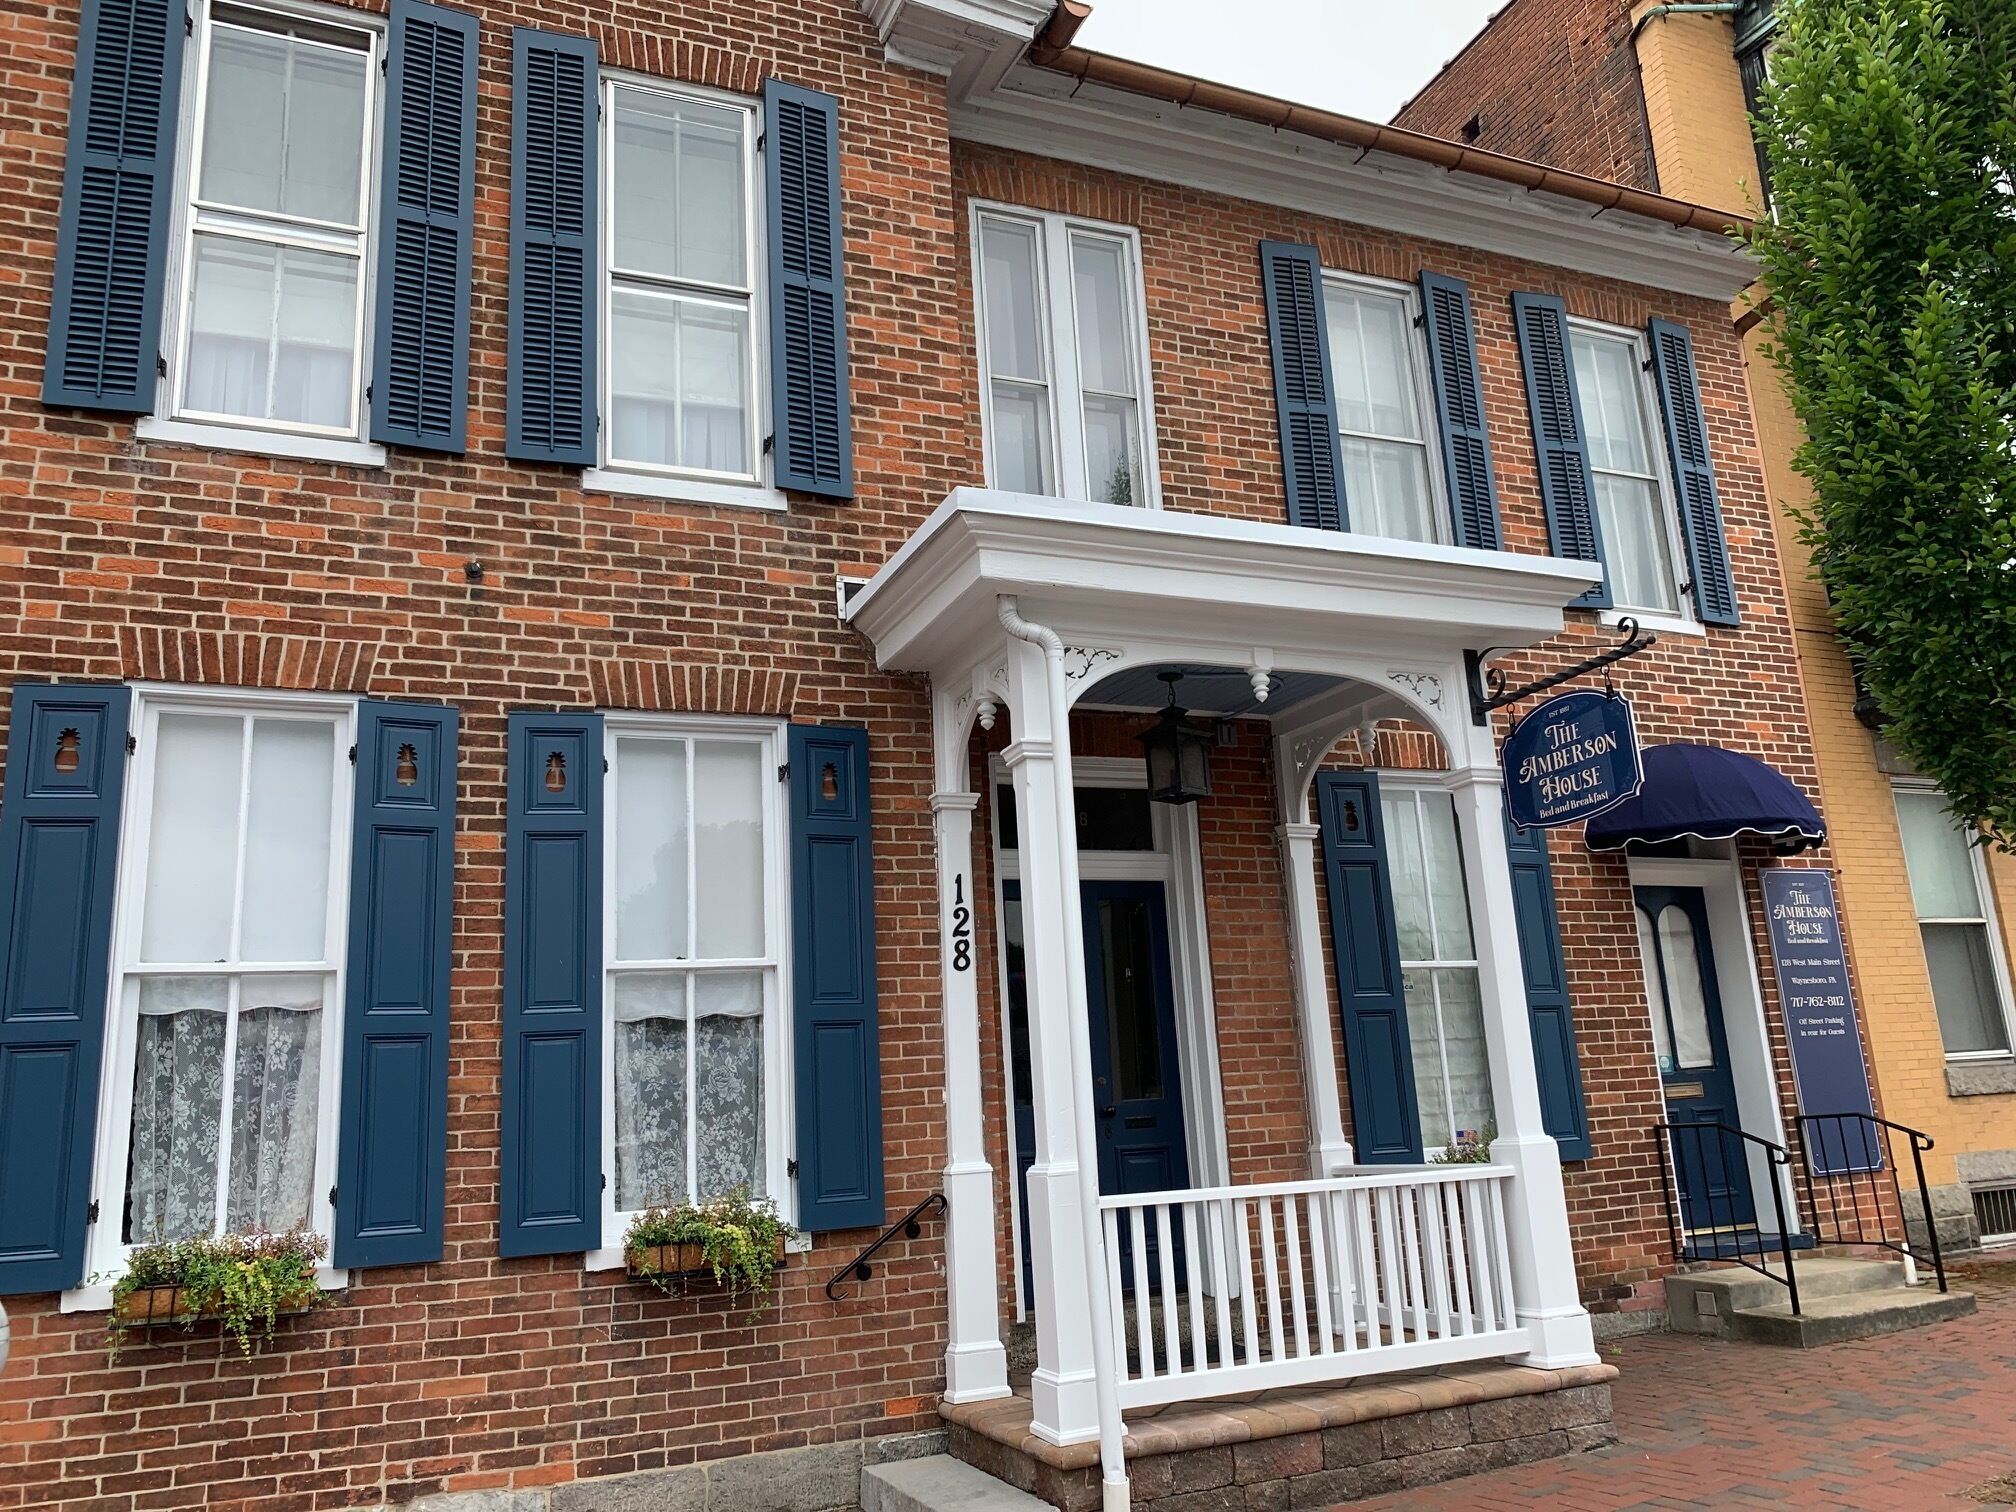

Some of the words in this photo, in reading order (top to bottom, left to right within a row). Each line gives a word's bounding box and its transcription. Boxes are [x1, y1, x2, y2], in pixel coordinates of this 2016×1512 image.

[1544, 720, 1582, 750] THE
[1519, 731, 1617, 784] AMBERSON
[1539, 766, 1603, 804] HOUSE
[1539, 806, 1554, 819] Bed
[1555, 801, 1570, 814] and
[1570, 790, 1609, 810] Breakfast
[1773, 904, 1832, 920] AMBERSON
[1789, 889, 1812, 906] THE
[952, 873, 971, 972] 128
[1786, 919, 1825, 936] HOUSE
[1790, 995, 1845, 1008] 717-762-8112
